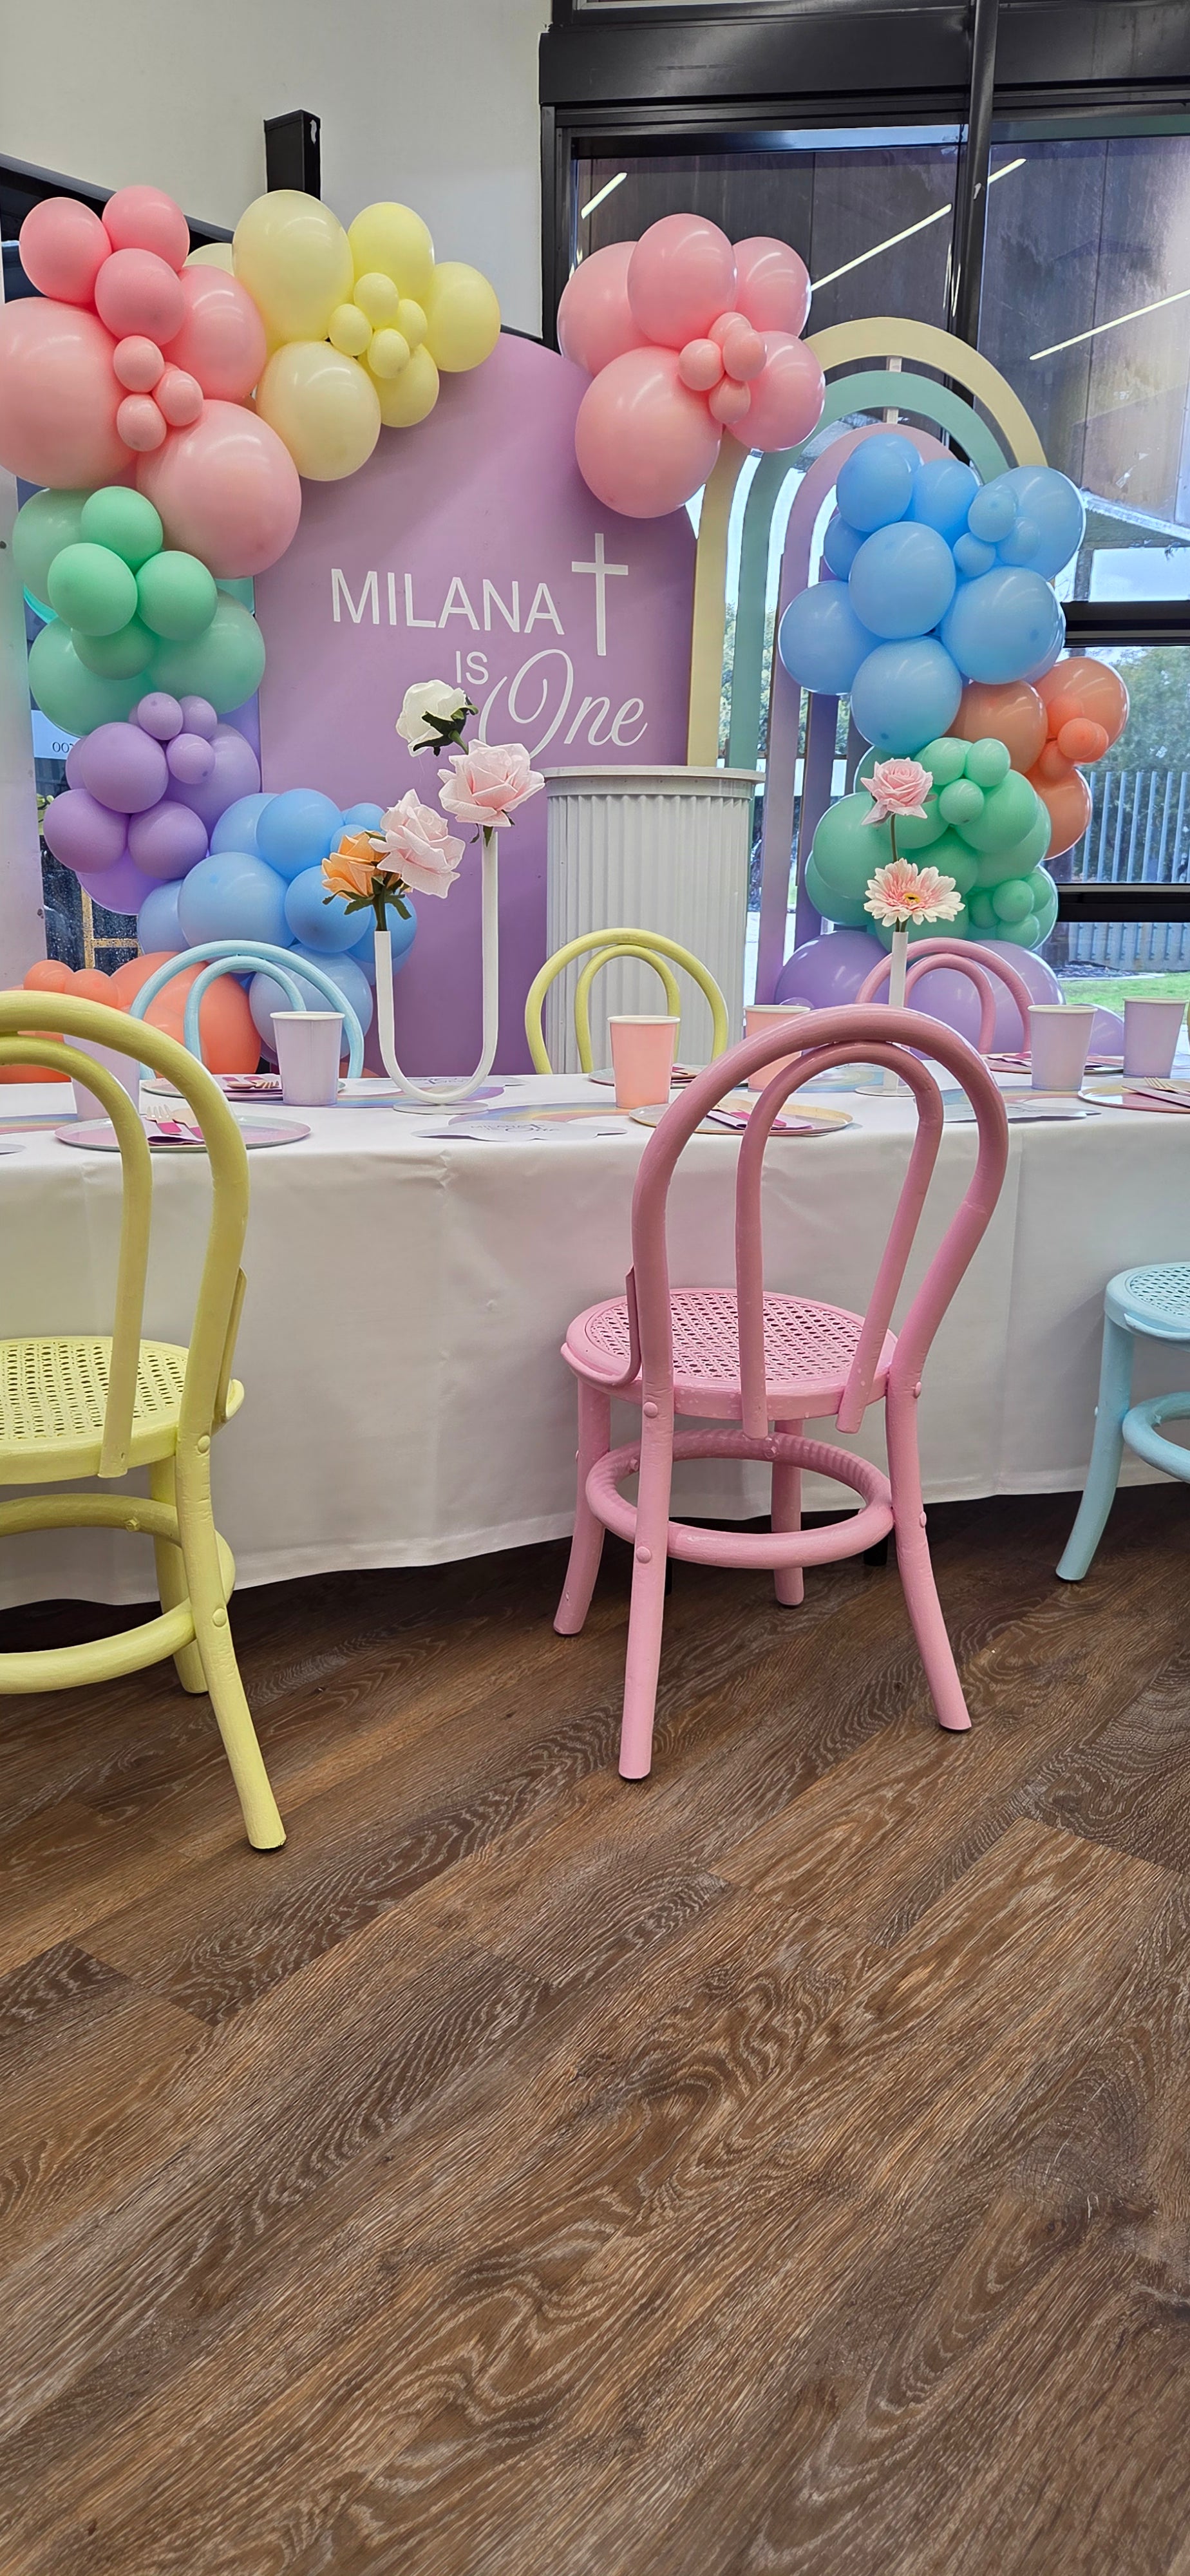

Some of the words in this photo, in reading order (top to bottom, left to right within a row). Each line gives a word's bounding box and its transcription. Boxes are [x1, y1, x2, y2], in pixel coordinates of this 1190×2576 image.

[331, 568, 565, 635] MILANA
[455, 650, 489, 685] IS
[478, 649, 648, 759] One
